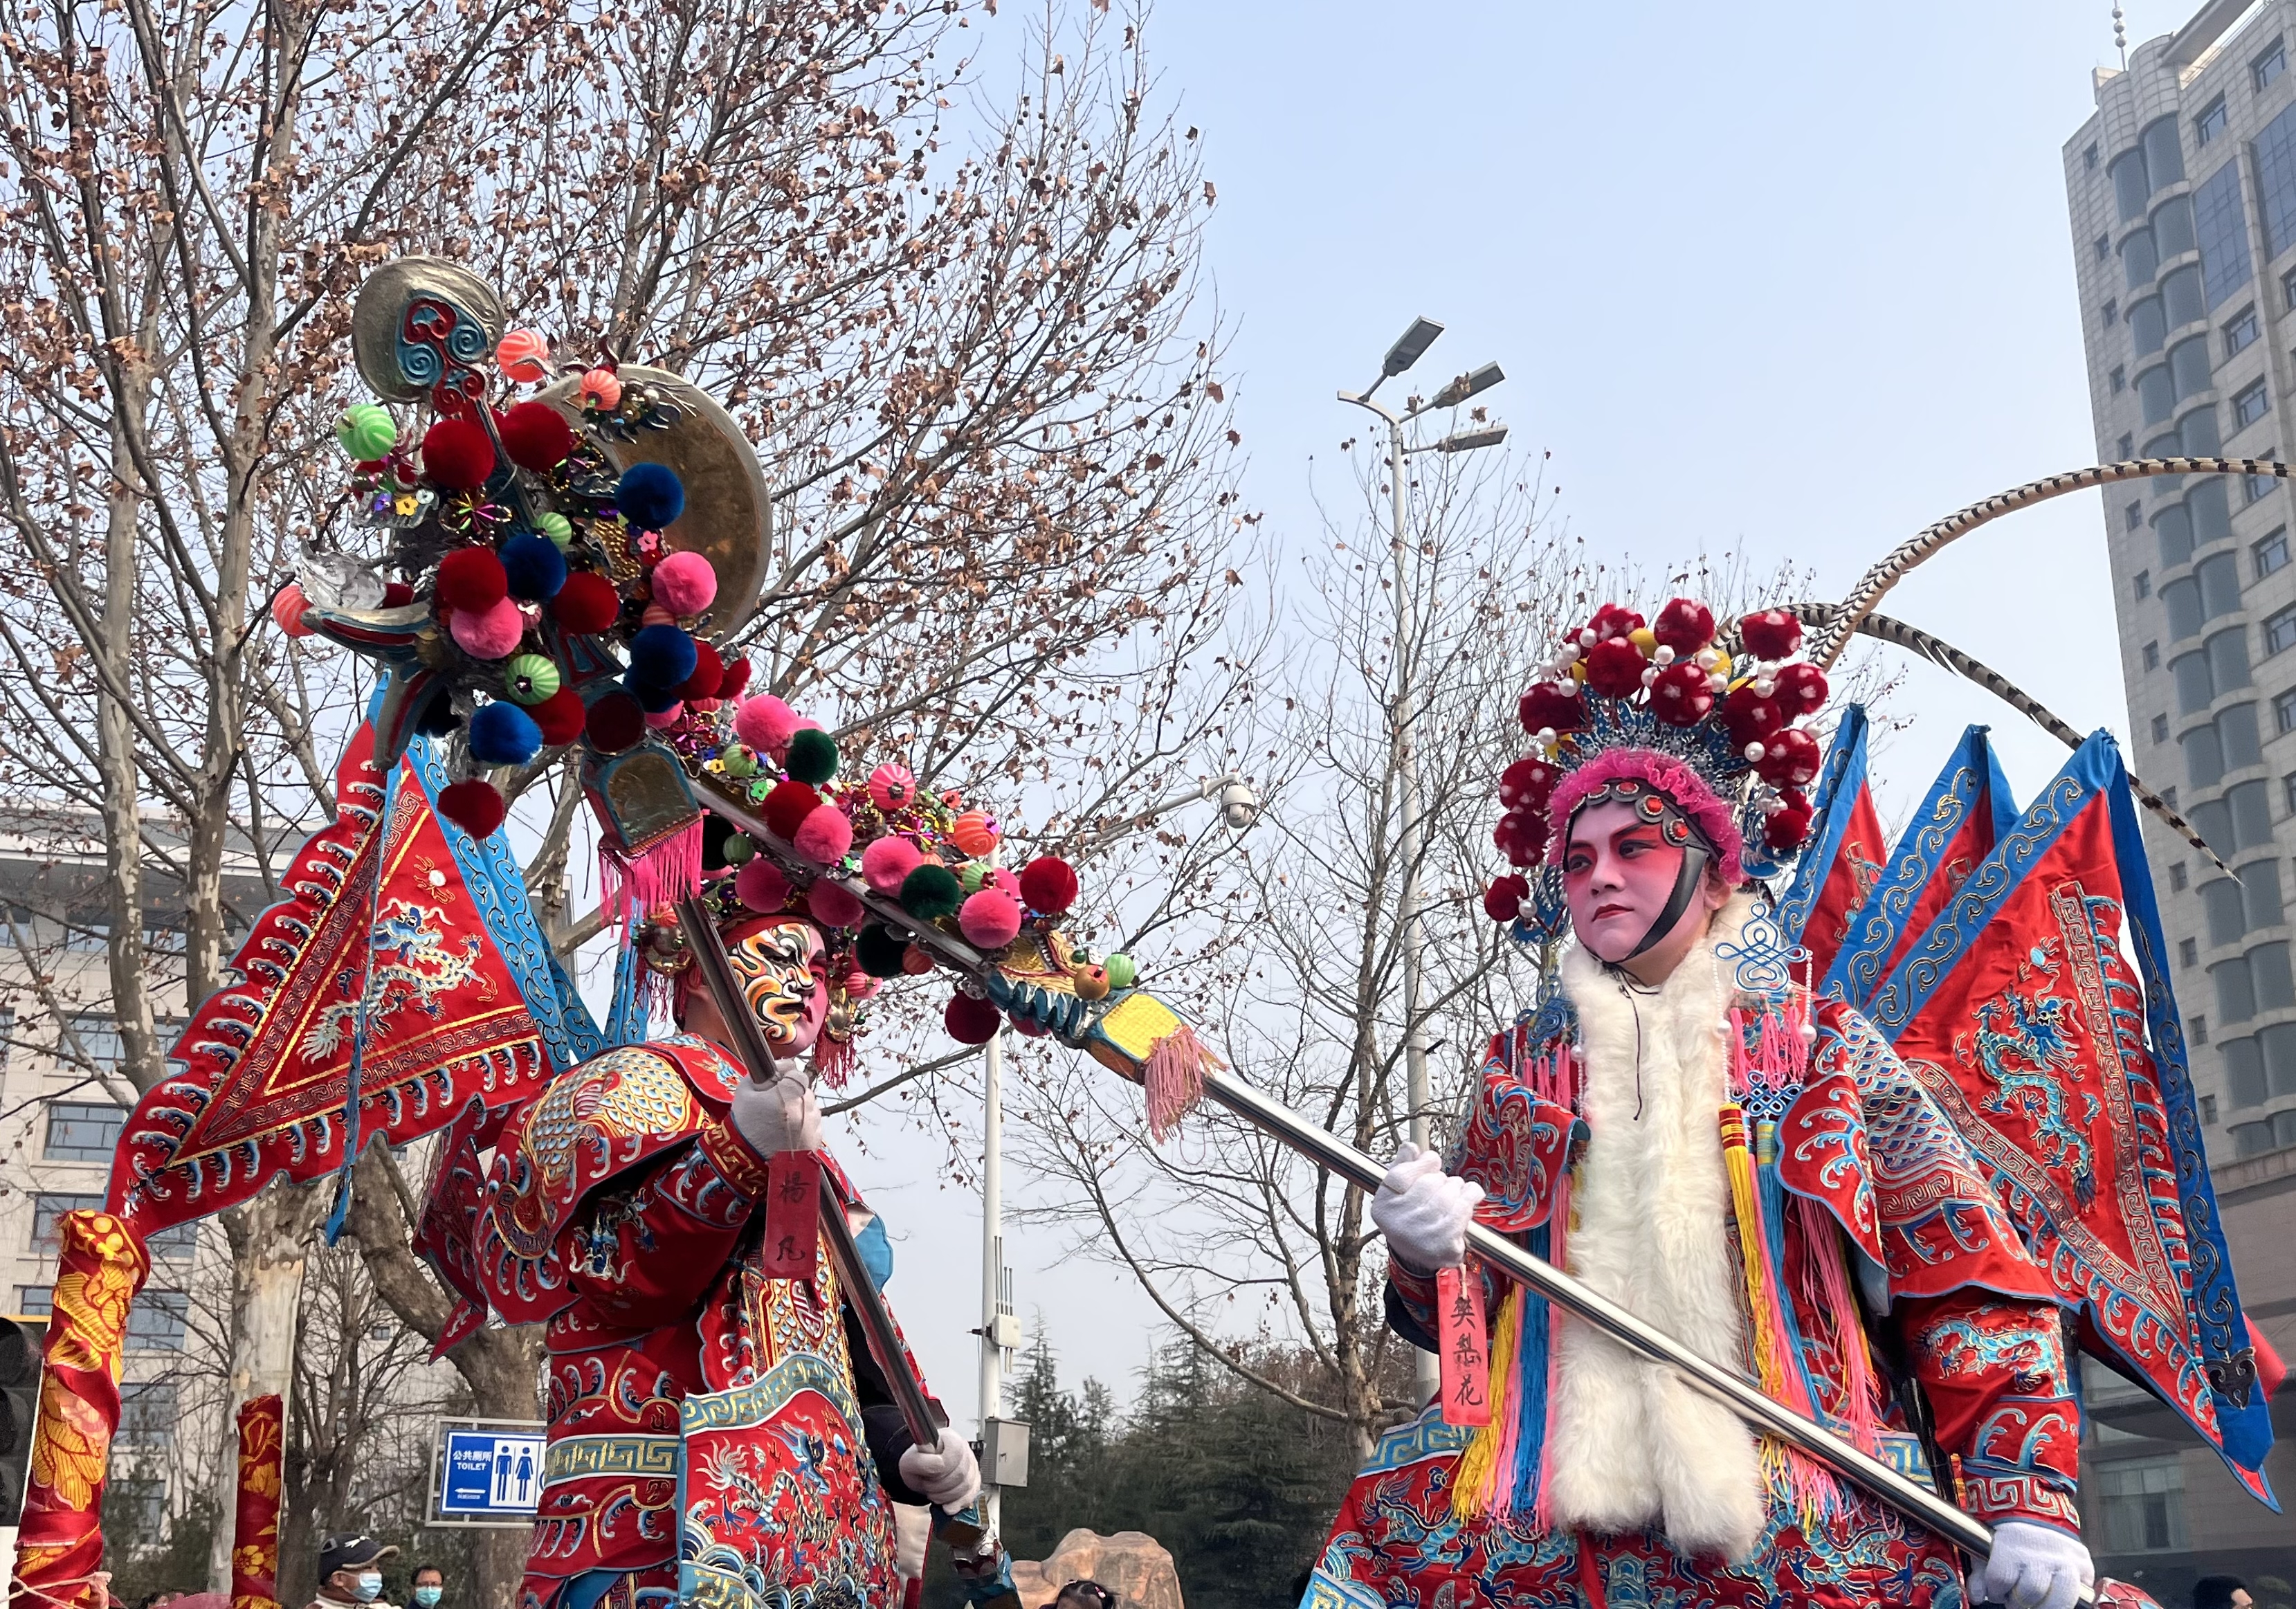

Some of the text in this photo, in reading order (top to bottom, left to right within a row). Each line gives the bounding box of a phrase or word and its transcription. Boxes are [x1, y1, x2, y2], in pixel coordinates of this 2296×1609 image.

[453, 1450, 493, 1462] 公共厕所
[457, 1462, 486, 1471] TOILET
